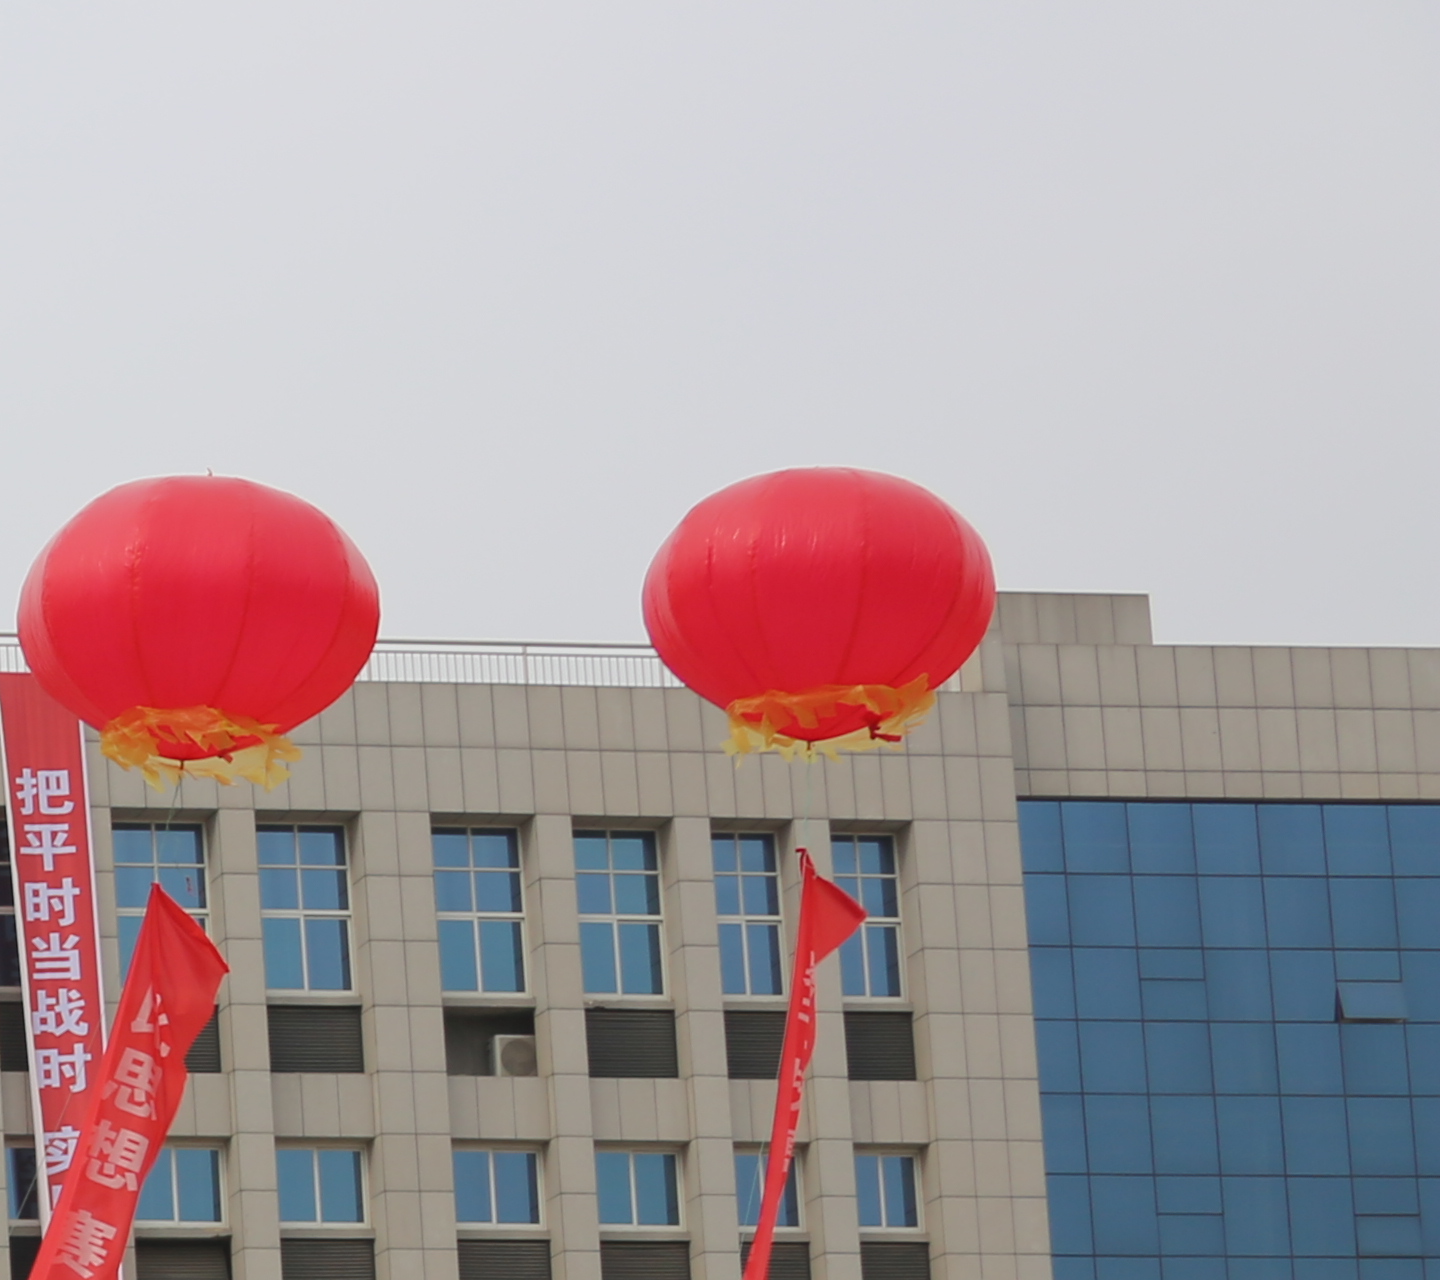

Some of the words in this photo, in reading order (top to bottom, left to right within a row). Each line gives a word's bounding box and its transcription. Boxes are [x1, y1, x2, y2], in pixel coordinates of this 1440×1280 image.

[16, 768, 92, 1093] 把平时当战时
